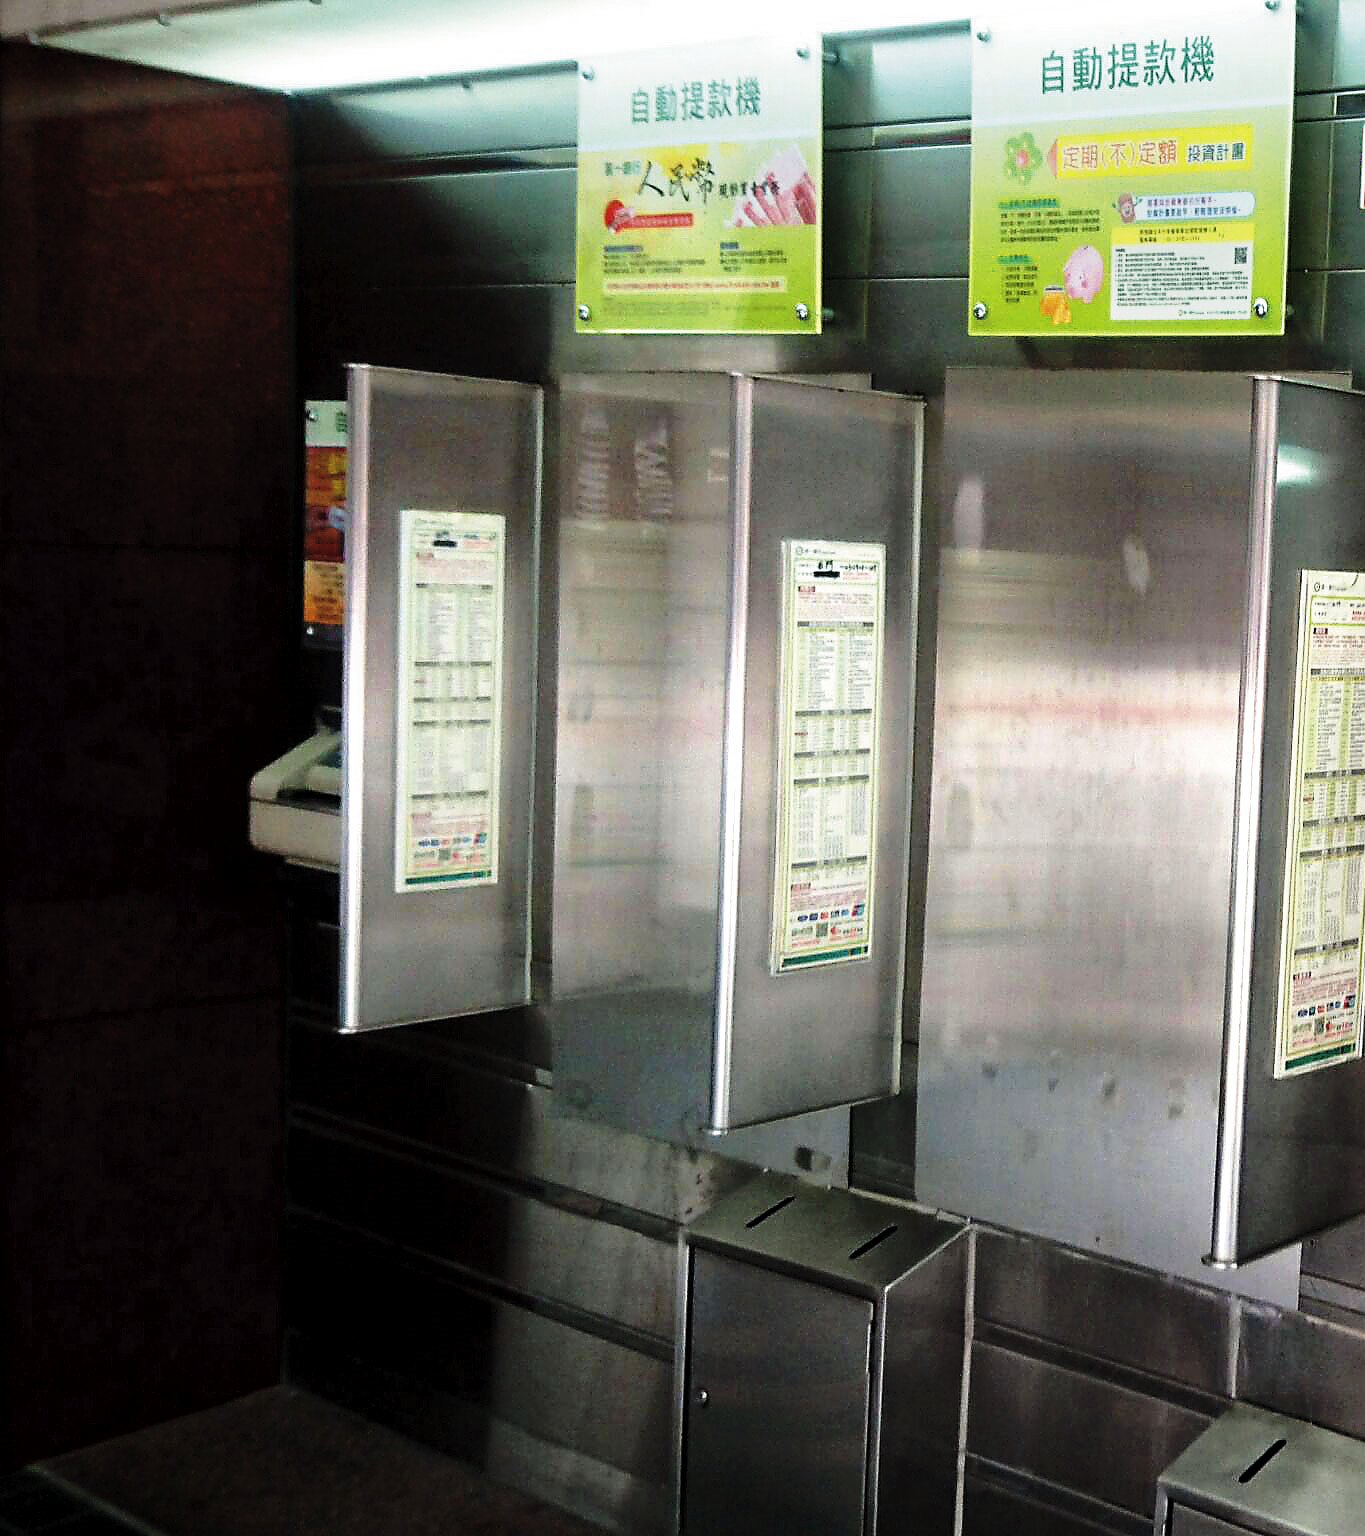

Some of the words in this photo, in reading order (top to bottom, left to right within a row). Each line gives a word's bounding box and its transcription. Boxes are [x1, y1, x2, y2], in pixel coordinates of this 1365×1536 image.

[1041, 35, 1215, 95] 自動提款機
[630, 76, 762, 125] 自動提款機
